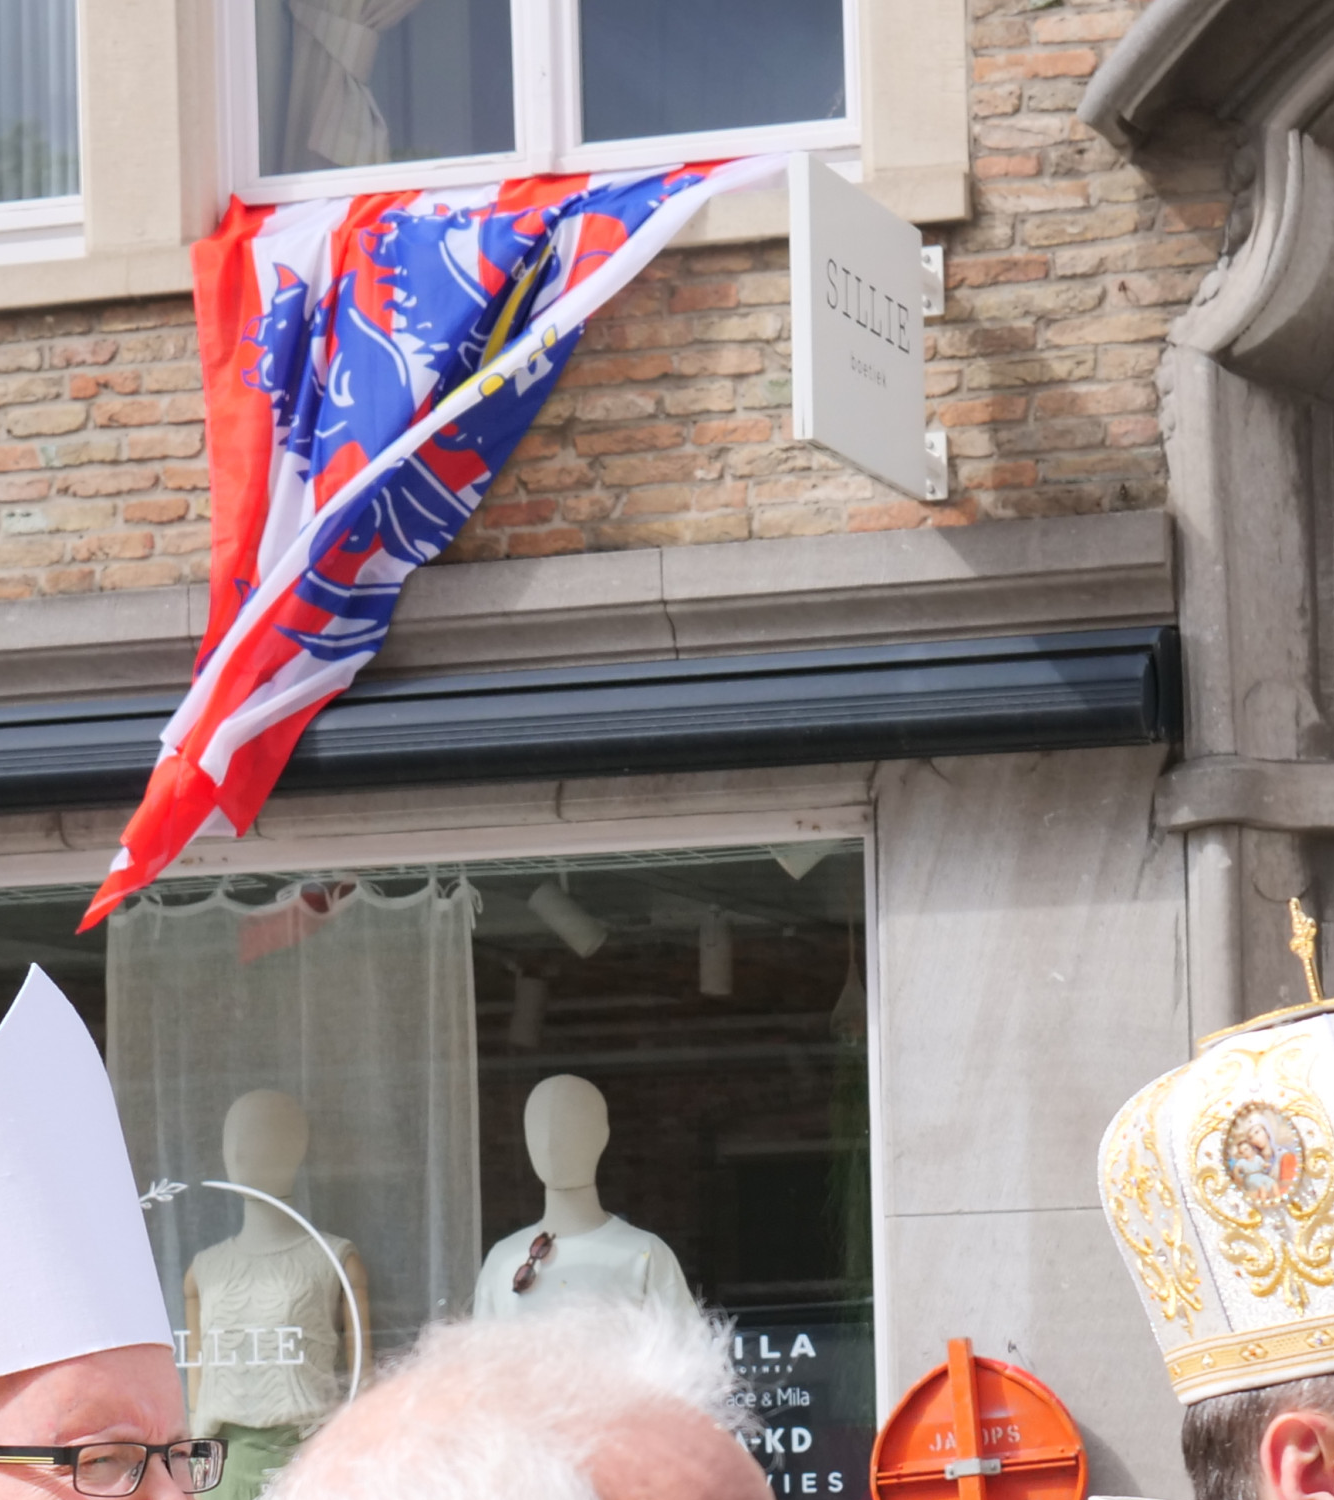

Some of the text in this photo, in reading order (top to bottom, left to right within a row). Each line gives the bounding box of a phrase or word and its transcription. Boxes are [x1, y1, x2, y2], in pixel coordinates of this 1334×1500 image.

[827, 258, 909, 354] SILLIE
[173, 1326, 304, 1368] LLIE
[734, 1333, 816, 1360] ILA
[727, 1386, 811, 1407] ace & Mila
[929, 1424, 1021, 1452] JAPS
